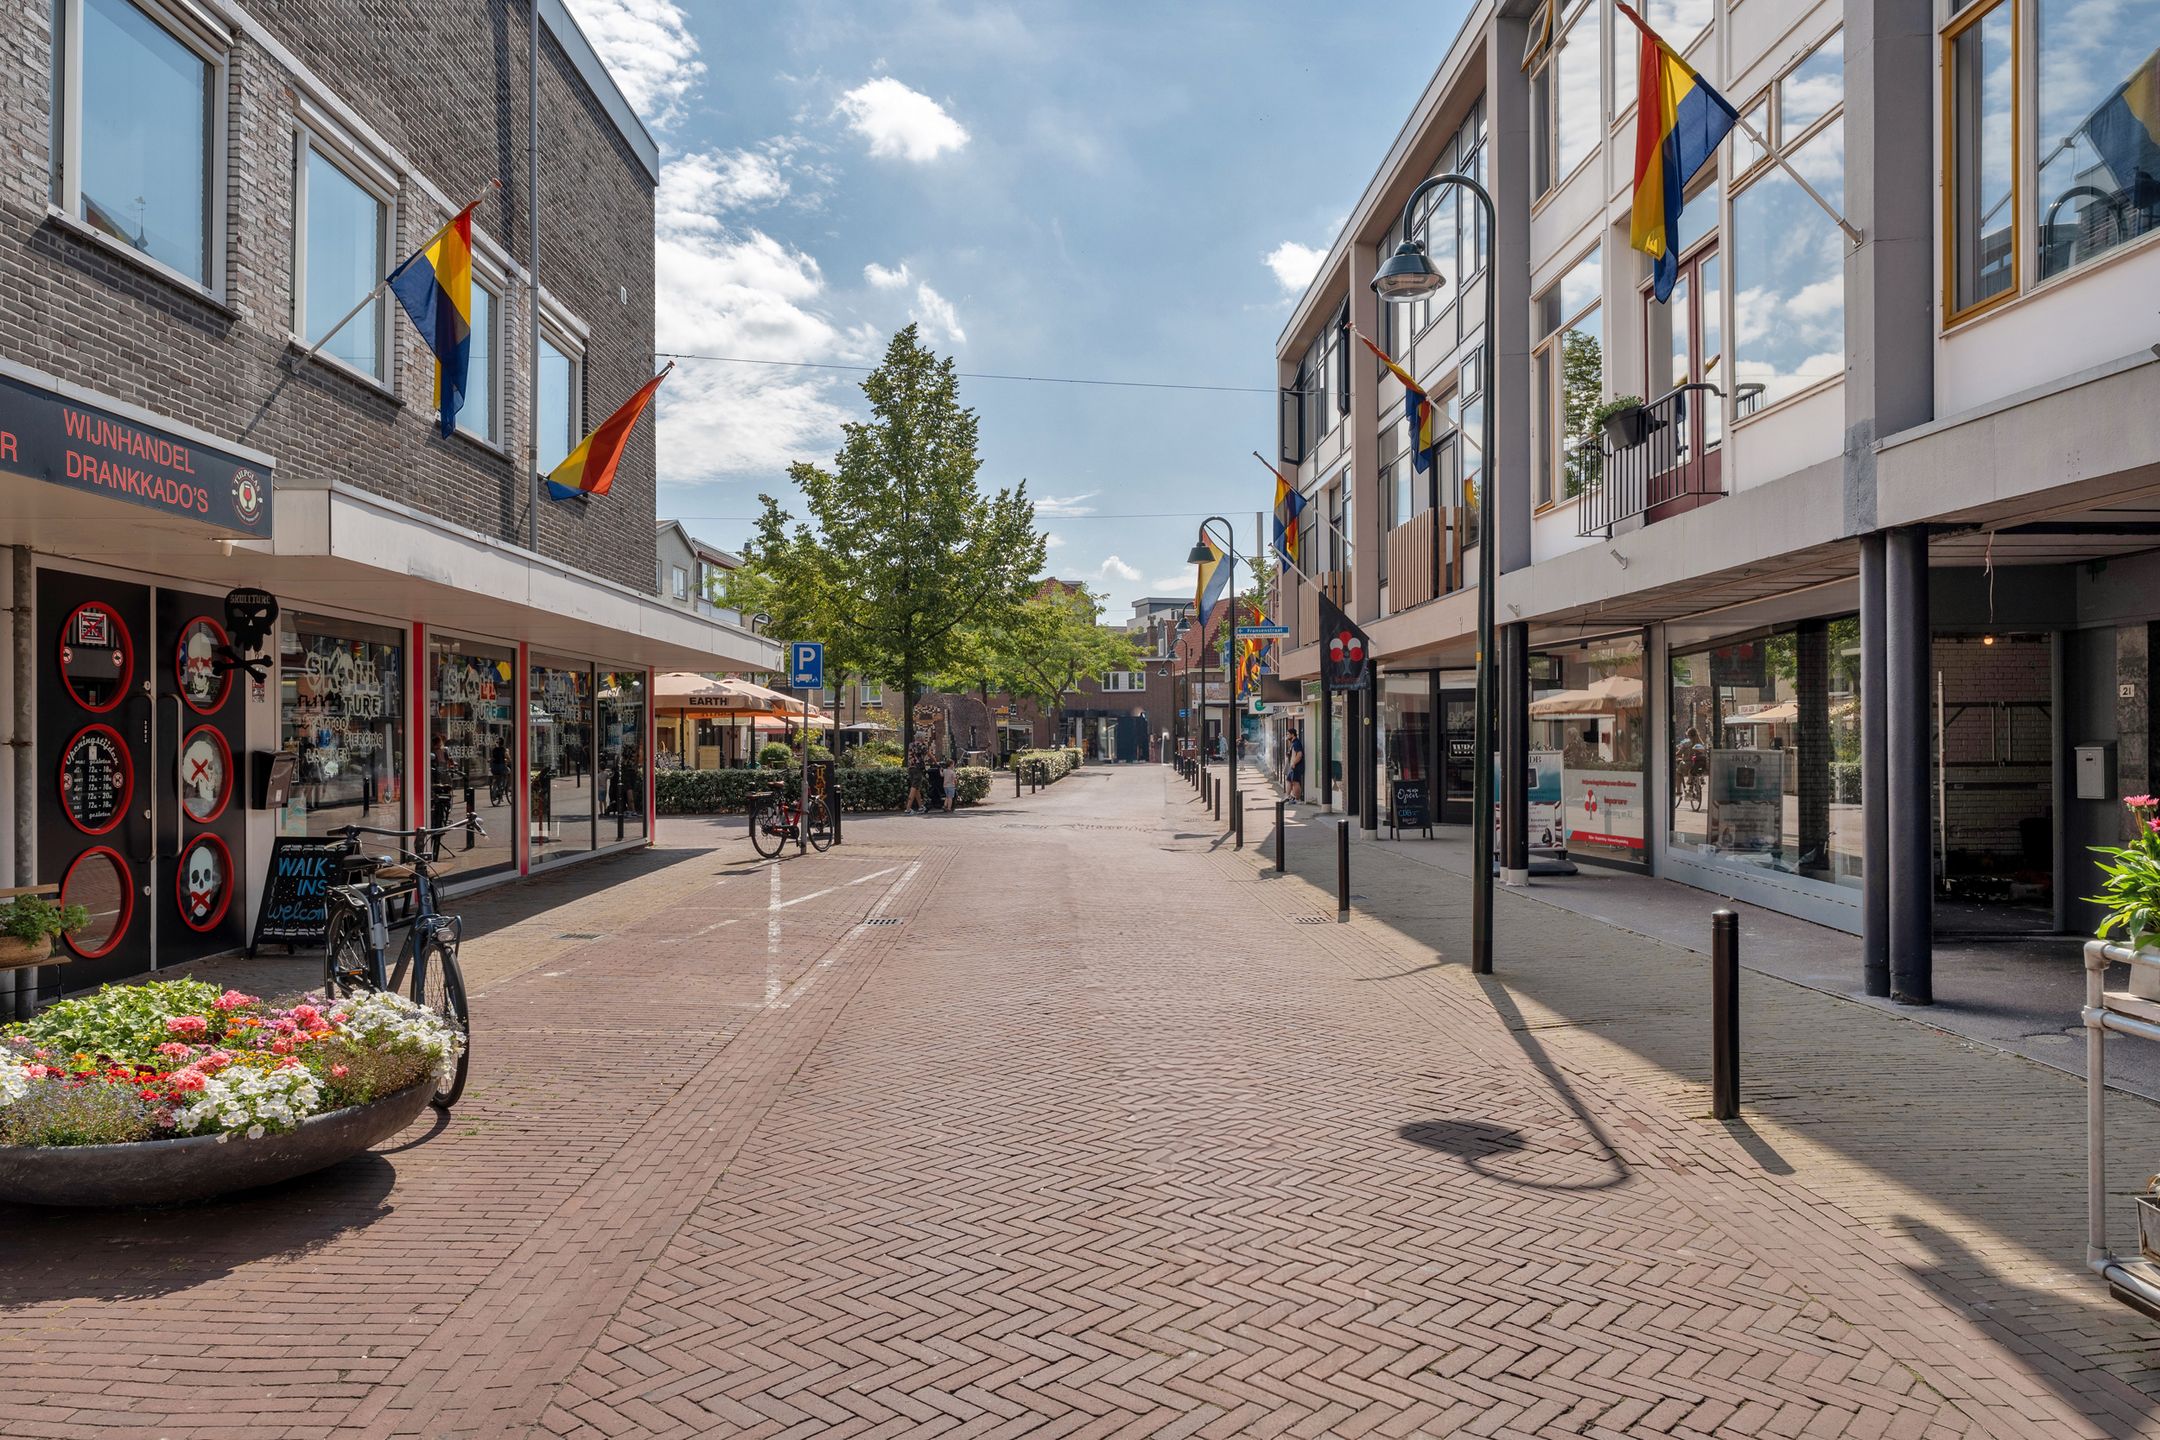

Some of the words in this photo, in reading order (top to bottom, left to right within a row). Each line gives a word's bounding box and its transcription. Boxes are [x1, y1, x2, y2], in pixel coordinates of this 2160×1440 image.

[63, 408, 195, 474] WIJNHANDEL
[66, 450, 209, 513] DRANKKADO'S
[230, 594, 270, 604] SKULLTURE
[800, 647, 816, 670] P
[689, 697, 728, 706] EARTH
[2122, 687, 2131, 695] 21
[342, 694, 382, 719] TURE
[66, 736, 119, 765] Openingstijden
[278, 857, 337, 877] WALK-
[296, 879, 328, 897] INS
